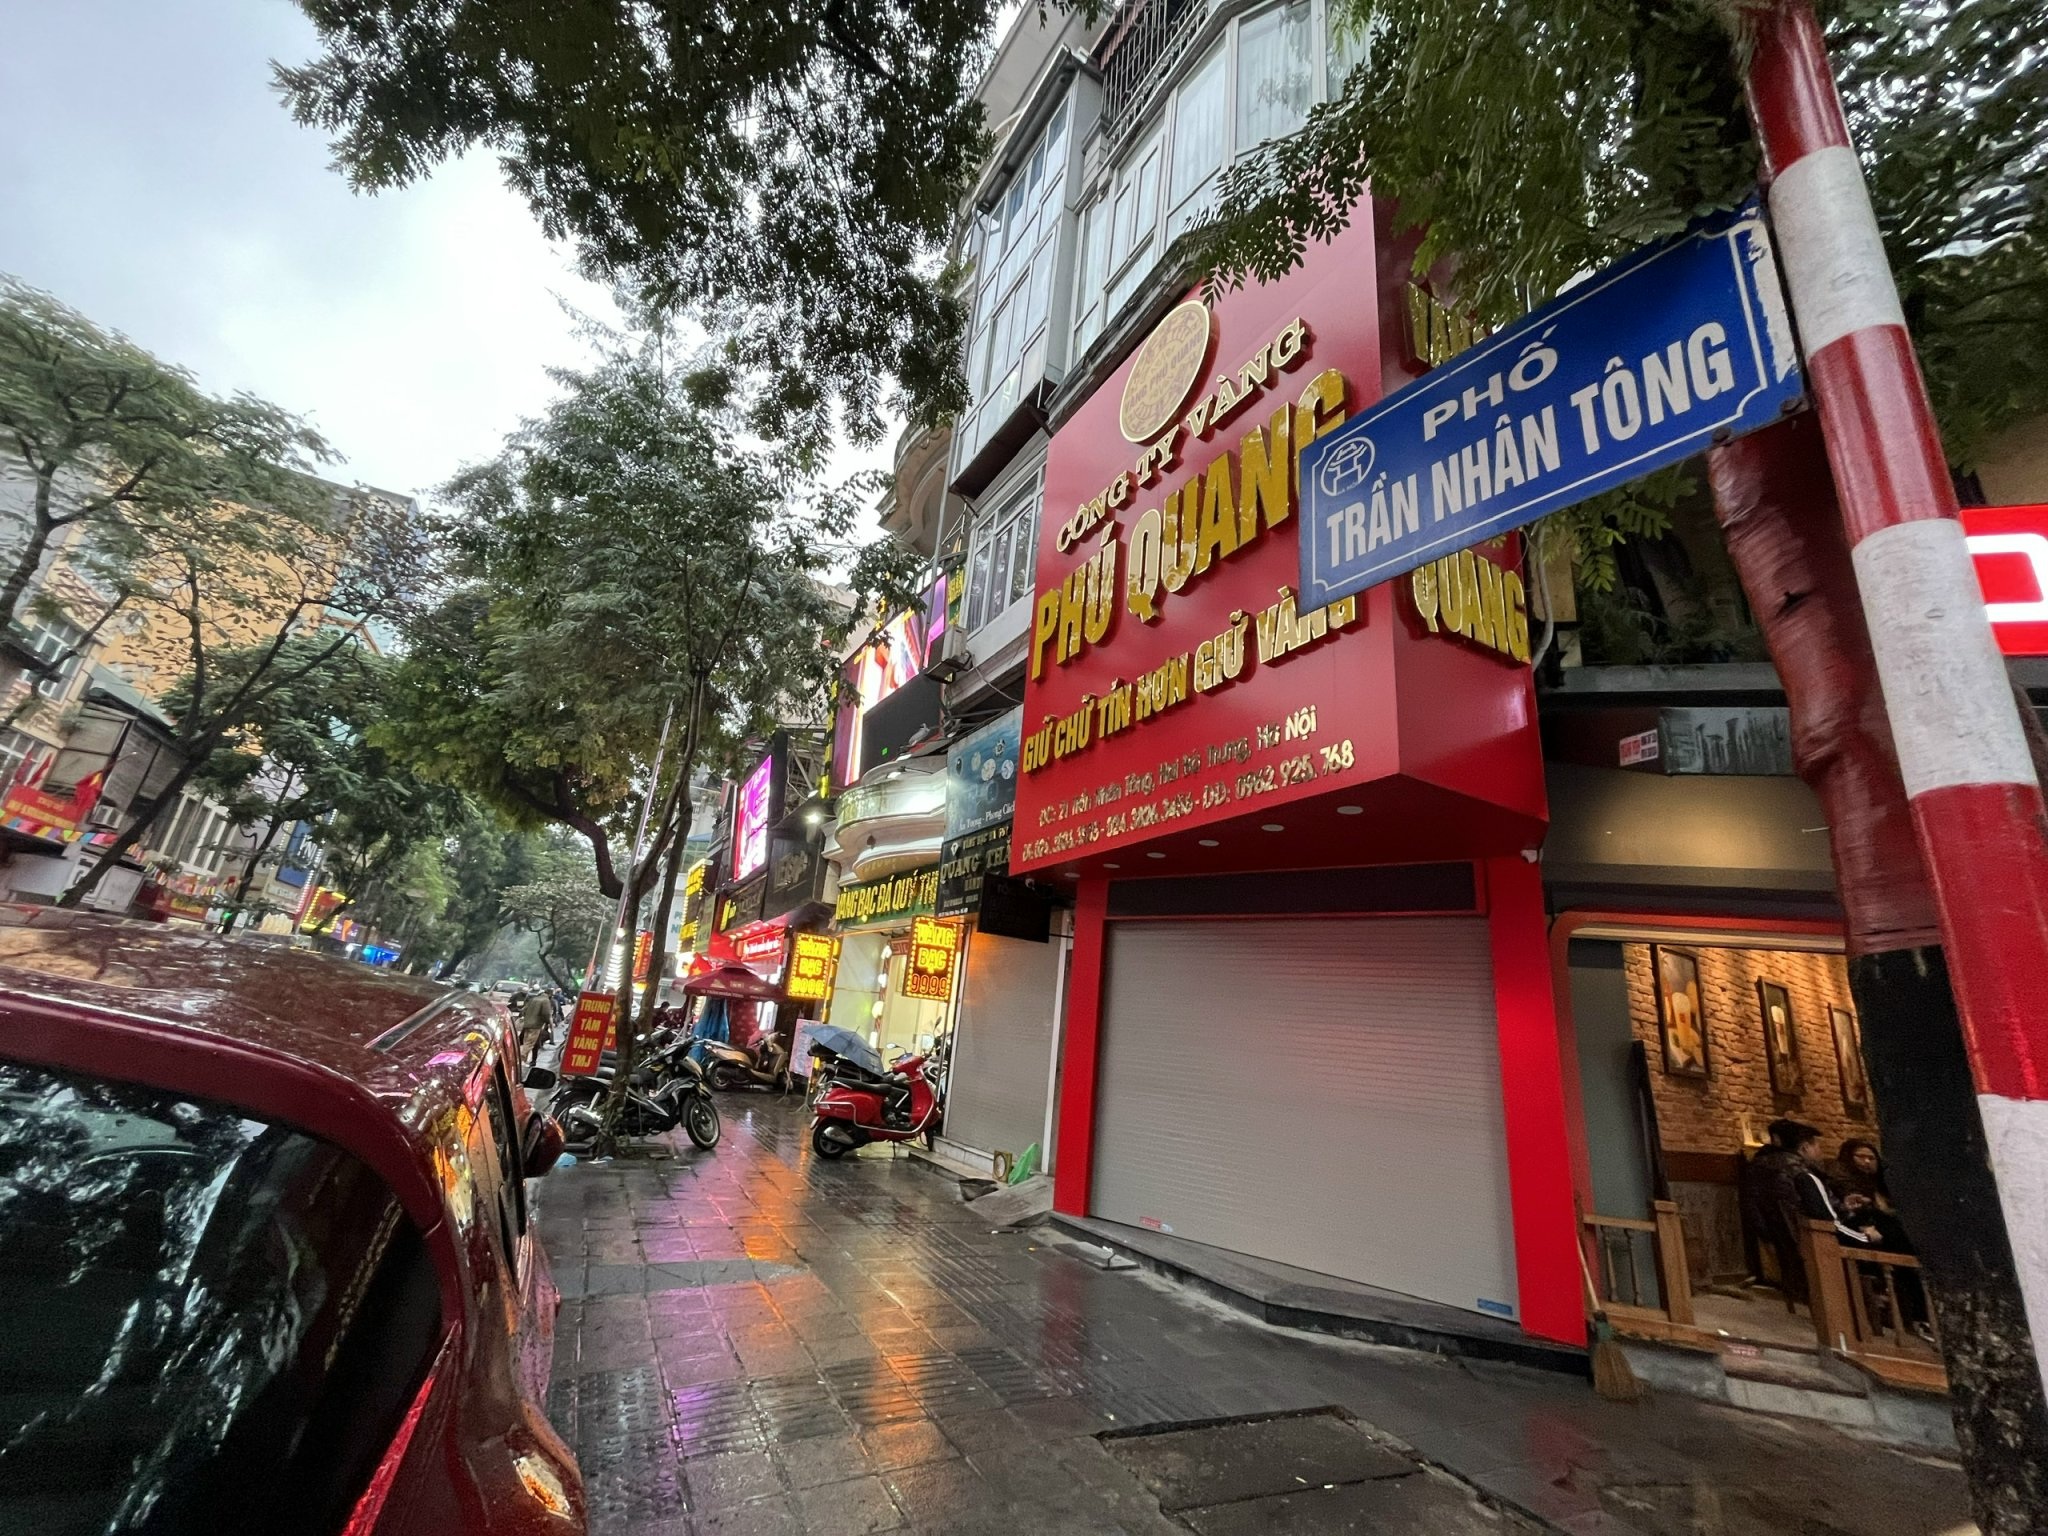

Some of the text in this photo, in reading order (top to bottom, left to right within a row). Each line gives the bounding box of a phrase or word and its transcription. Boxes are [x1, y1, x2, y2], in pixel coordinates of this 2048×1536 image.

[1423, 324, 1559, 441] PHỐ
[1056, 317, 1306, 552] CÔNG TY VÀNG
[1326, 320, 1736, 568] TRẦN NHÂN TÔNG
[1032, 520, 1117, 680] PHÚ
[1054, 692, 1097, 760] CHỮ
[1098, 677, 1132, 739] TÍN
[1136, 652, 1190, 721] HƠN
[1194, 609, 1248, 693] GIỮ
[1159, 758, 1179, 785] Hai
[1285, 704, 1317, 741] Nội
[940, 853, 980, 884] QUANG
[877, 875, 895, 913] ĐÁ
[892, 868, 919, 911] QUÝ
[917, 921, 953, 948] VÀNG
[799, 957, 822, 977] BẠC
[917, 948, 947, 974] BẠC
[911, 973, 949, 996] 9999
[580, 999, 611, 1015] TRUNG
[581, 1017, 602, 1032] TÂM
[573, 1036, 598, 1051] VÀNG
[571, 1054, 592, 1068] TMJ
